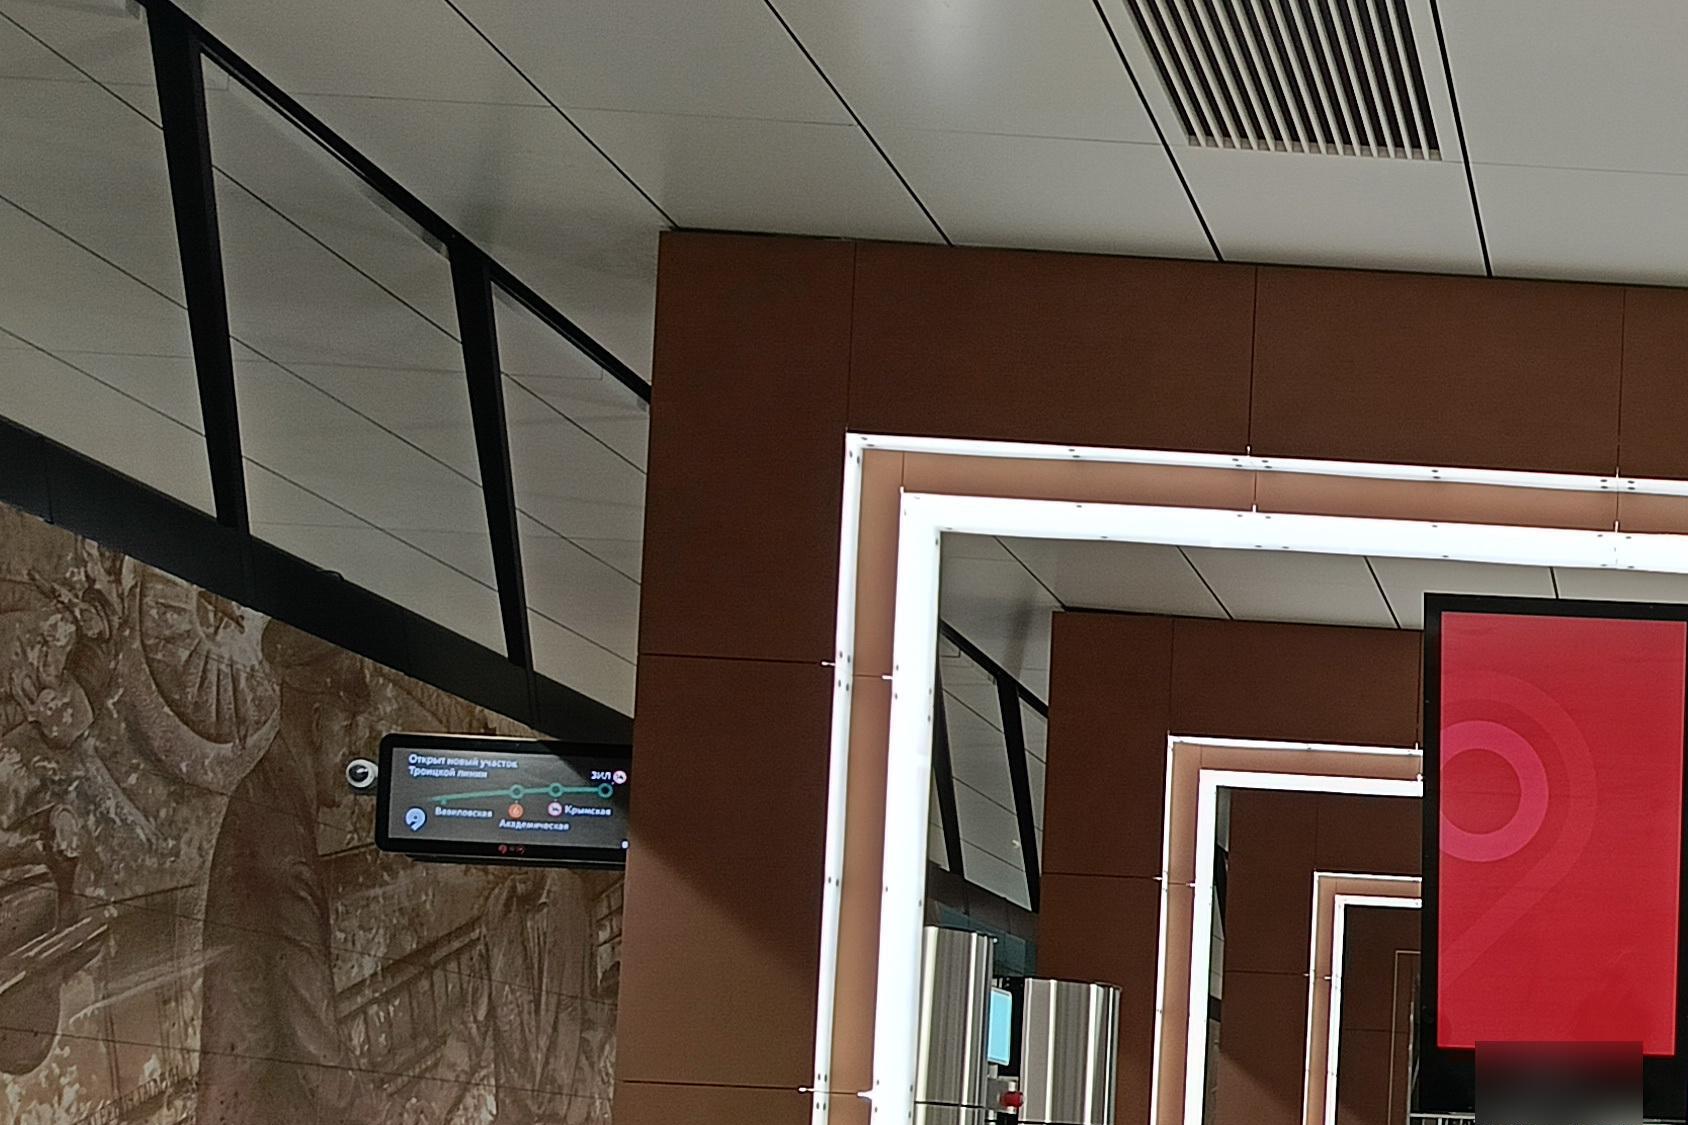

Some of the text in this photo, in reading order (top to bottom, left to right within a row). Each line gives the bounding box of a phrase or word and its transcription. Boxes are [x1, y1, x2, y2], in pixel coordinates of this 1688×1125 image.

[408, 754, 518, 769] Открыт новый участок
[408, 766, 456, 778] Троицкой
[591, 770, 611, 780] ЗИЛ
[565, 805, 612, 816] Крымская
[499, 819, 570, 831] Академическая
